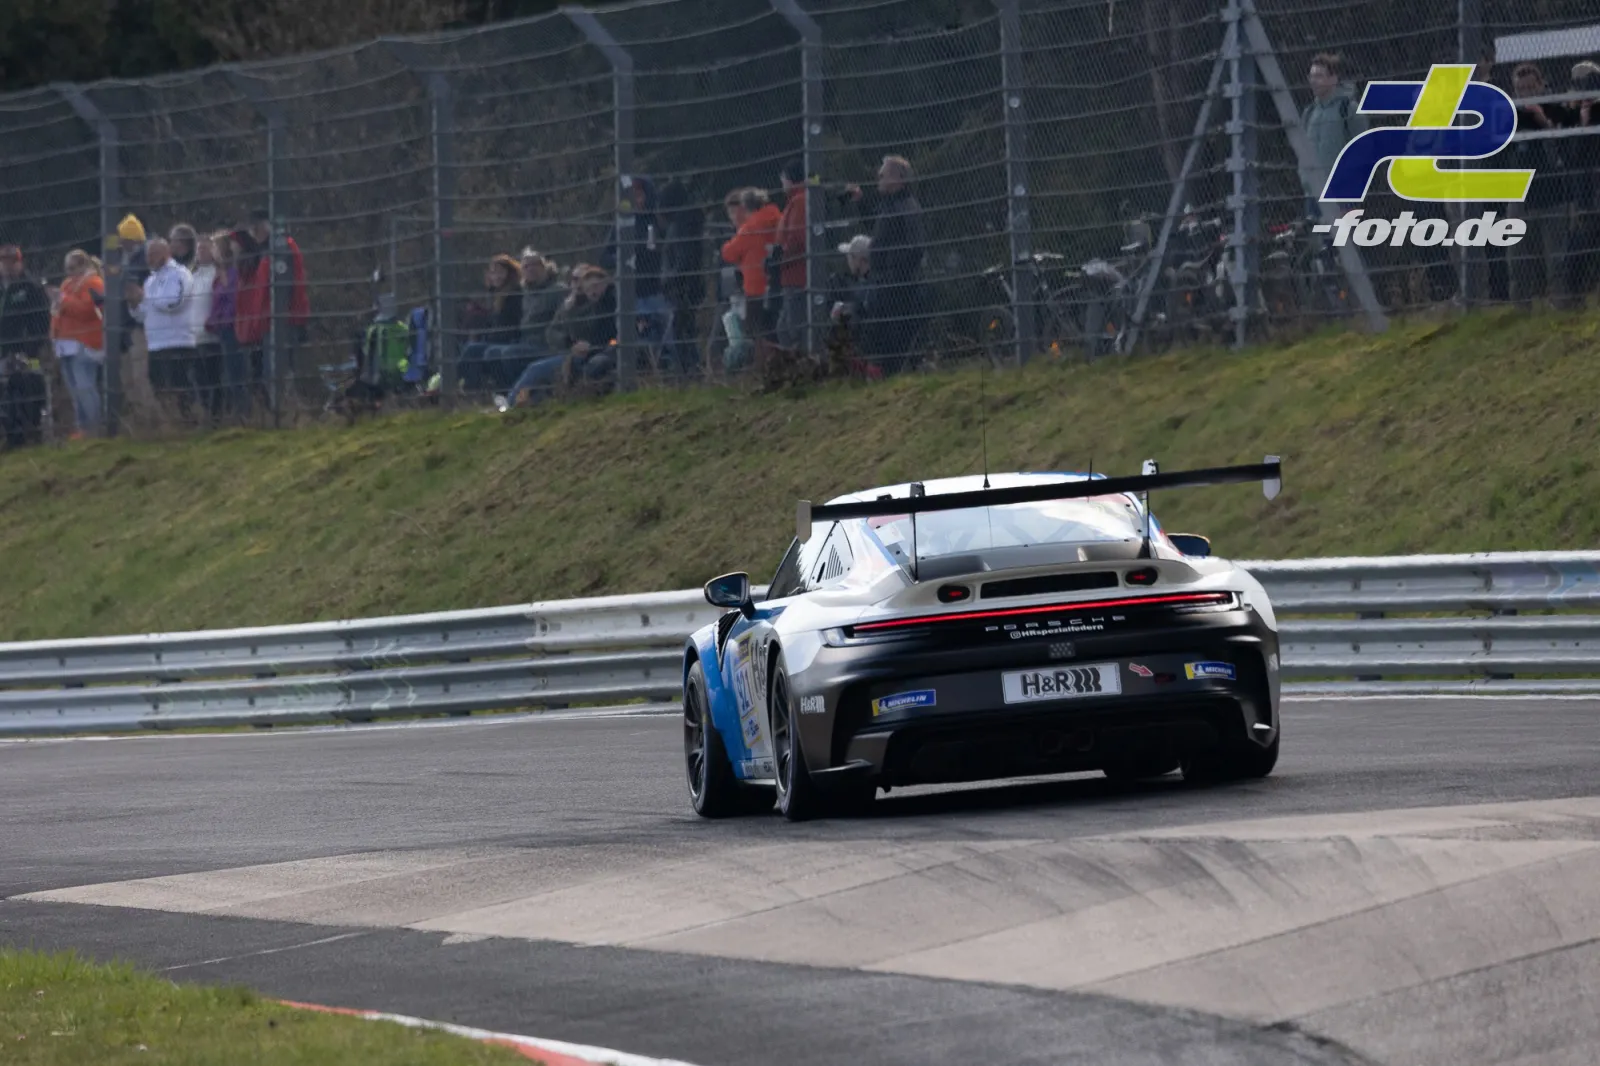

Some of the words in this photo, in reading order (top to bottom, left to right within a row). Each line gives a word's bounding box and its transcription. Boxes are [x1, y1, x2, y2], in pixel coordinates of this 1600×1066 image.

[985, 615, 1126, 631] PORSCHE
[1021, 671, 1072, 697] H&R
[887, 694, 927, 707] MICHELIN
